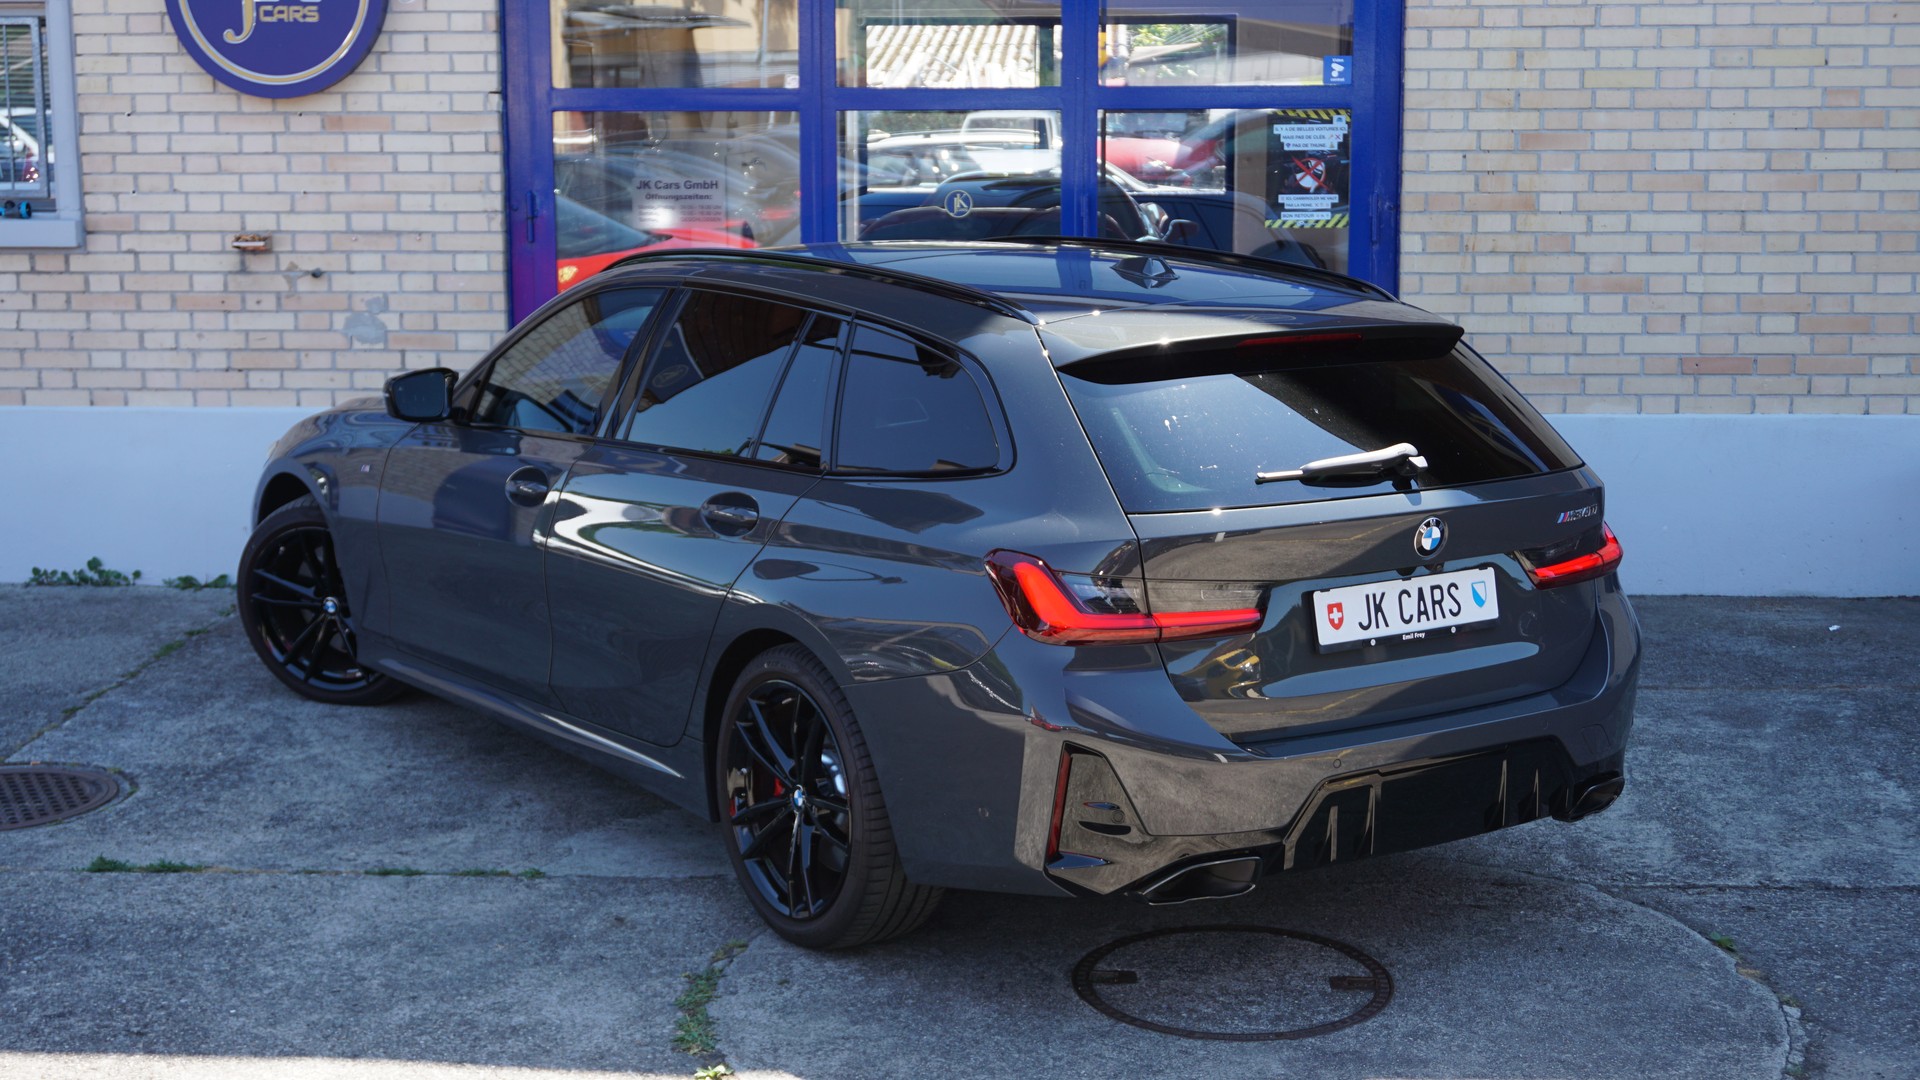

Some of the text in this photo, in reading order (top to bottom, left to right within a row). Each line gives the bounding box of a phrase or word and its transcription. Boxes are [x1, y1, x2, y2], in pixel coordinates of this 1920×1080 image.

[258, 5, 320, 22] CARS
[636, 180, 718, 190] JK Cars GmbH
[1358, 582, 1461, 630] JK CARS
